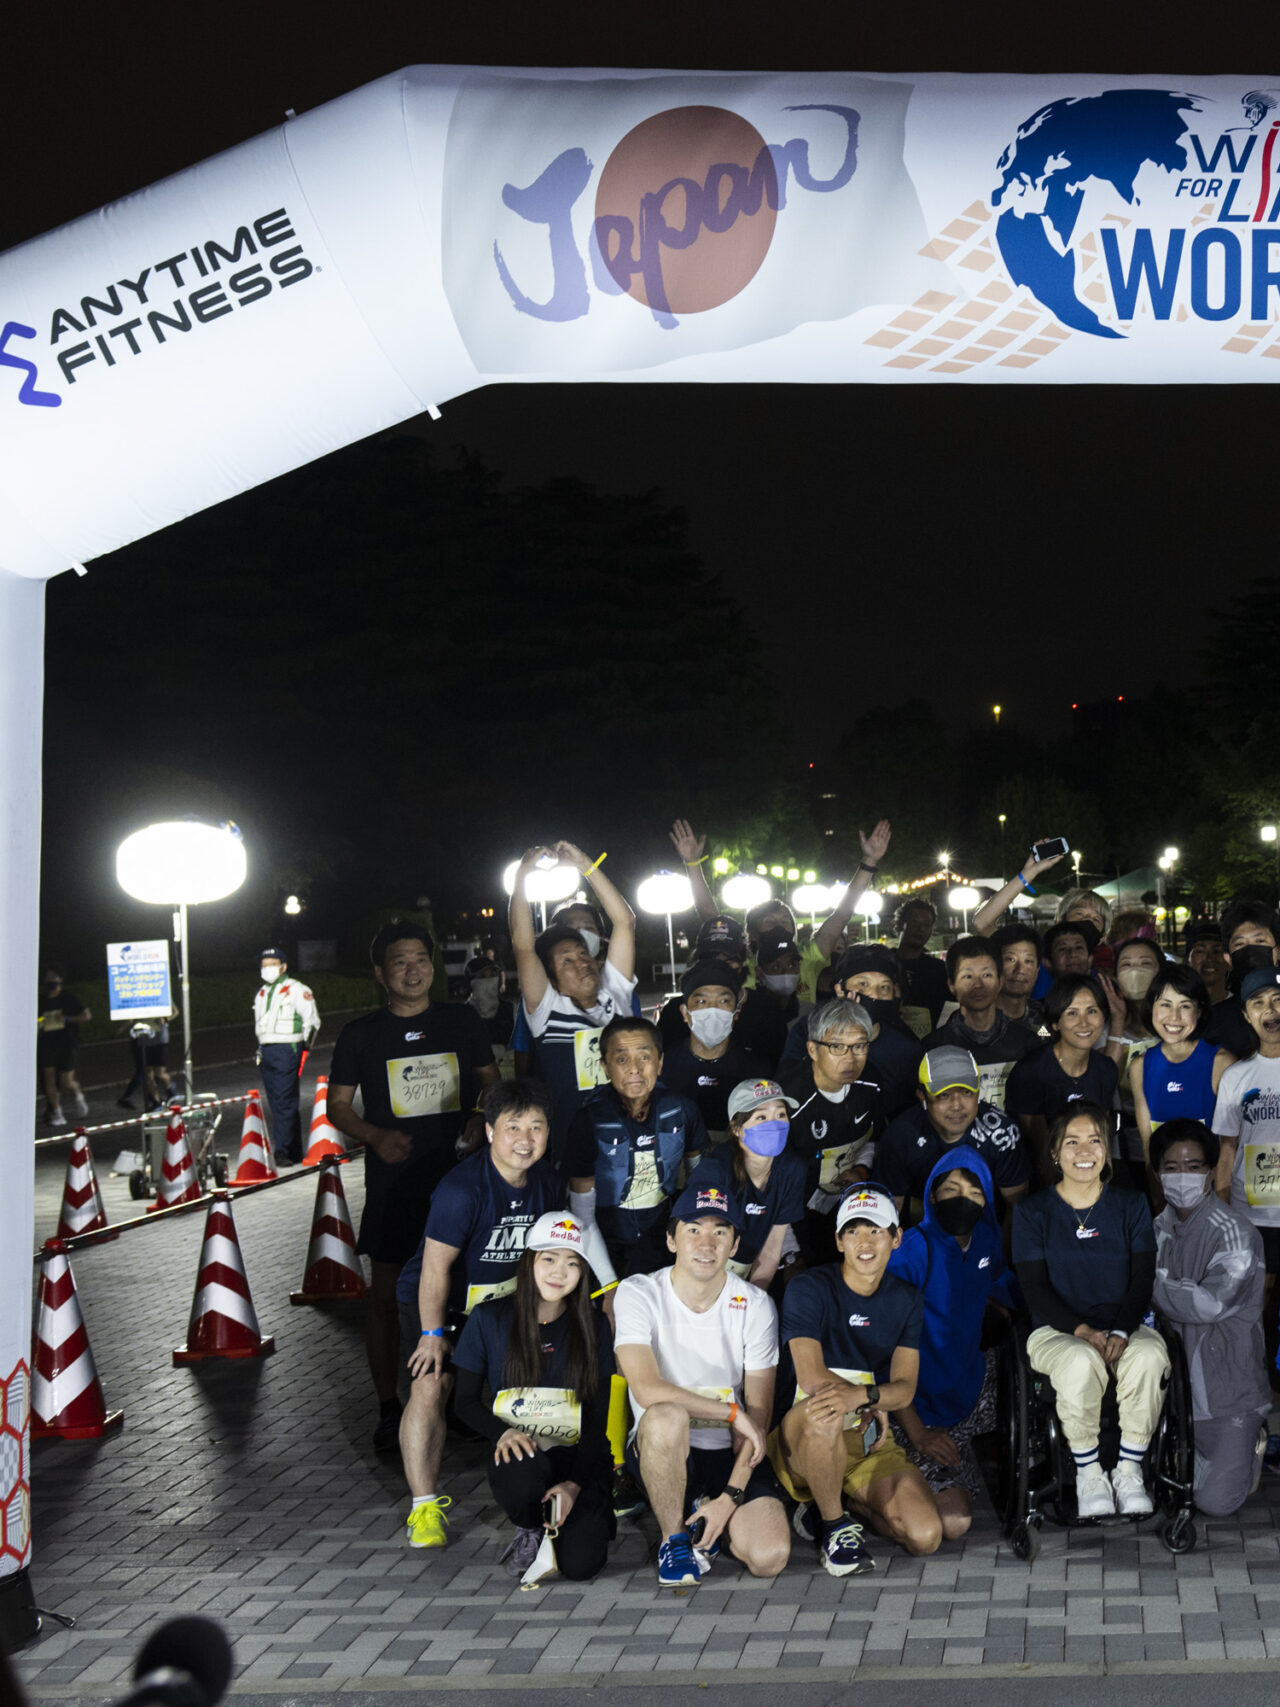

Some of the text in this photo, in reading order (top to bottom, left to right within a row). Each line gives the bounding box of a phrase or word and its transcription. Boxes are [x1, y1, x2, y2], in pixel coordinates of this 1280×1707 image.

[494, 103, 861, 330] Japan
[1175, 178, 1223, 198] FOR
[49, 208, 296, 345] ANYTIME
[57, 245, 314, 385] FITNESS
[402, 1080, 446, 1102] 38729
[550, 1231, 581, 1243] Red Bull
